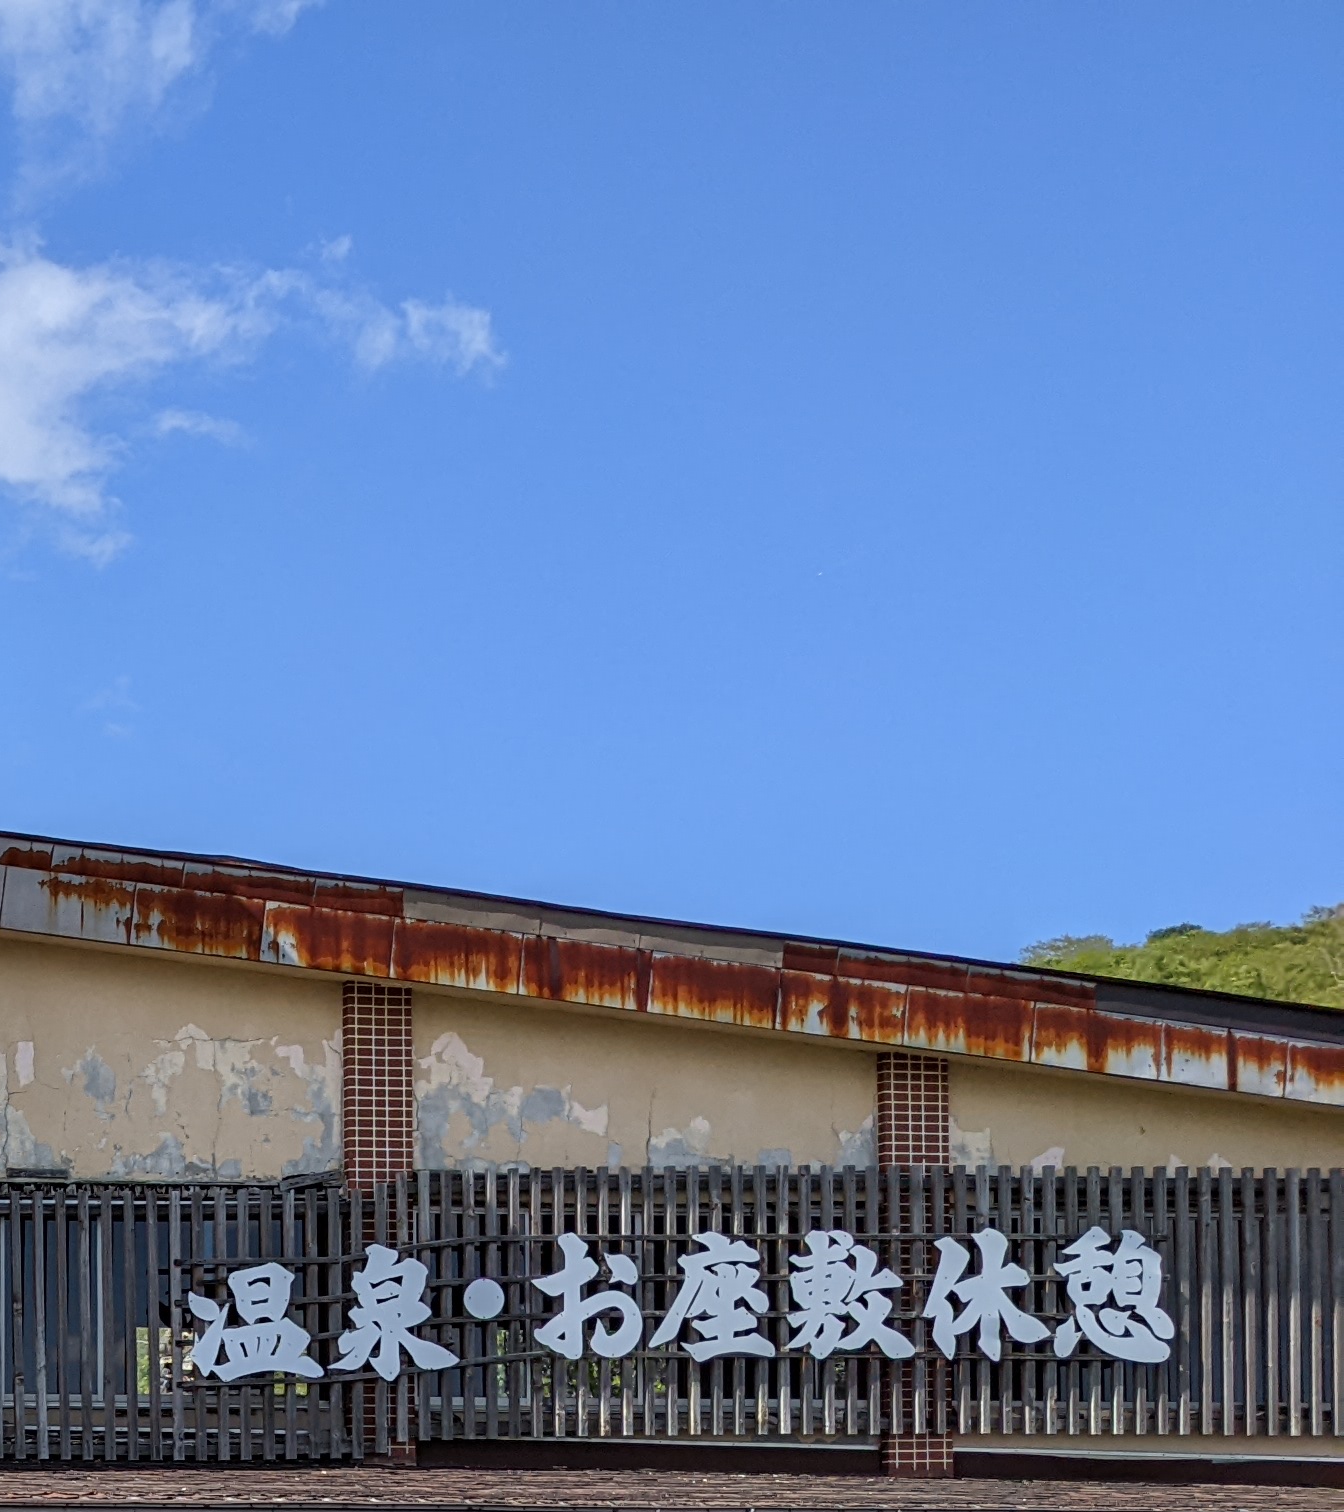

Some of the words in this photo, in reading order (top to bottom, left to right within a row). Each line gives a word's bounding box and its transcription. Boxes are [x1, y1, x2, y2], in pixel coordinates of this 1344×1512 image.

[187, 1225, 1177, 1382] 温泉・お座敷休憩
